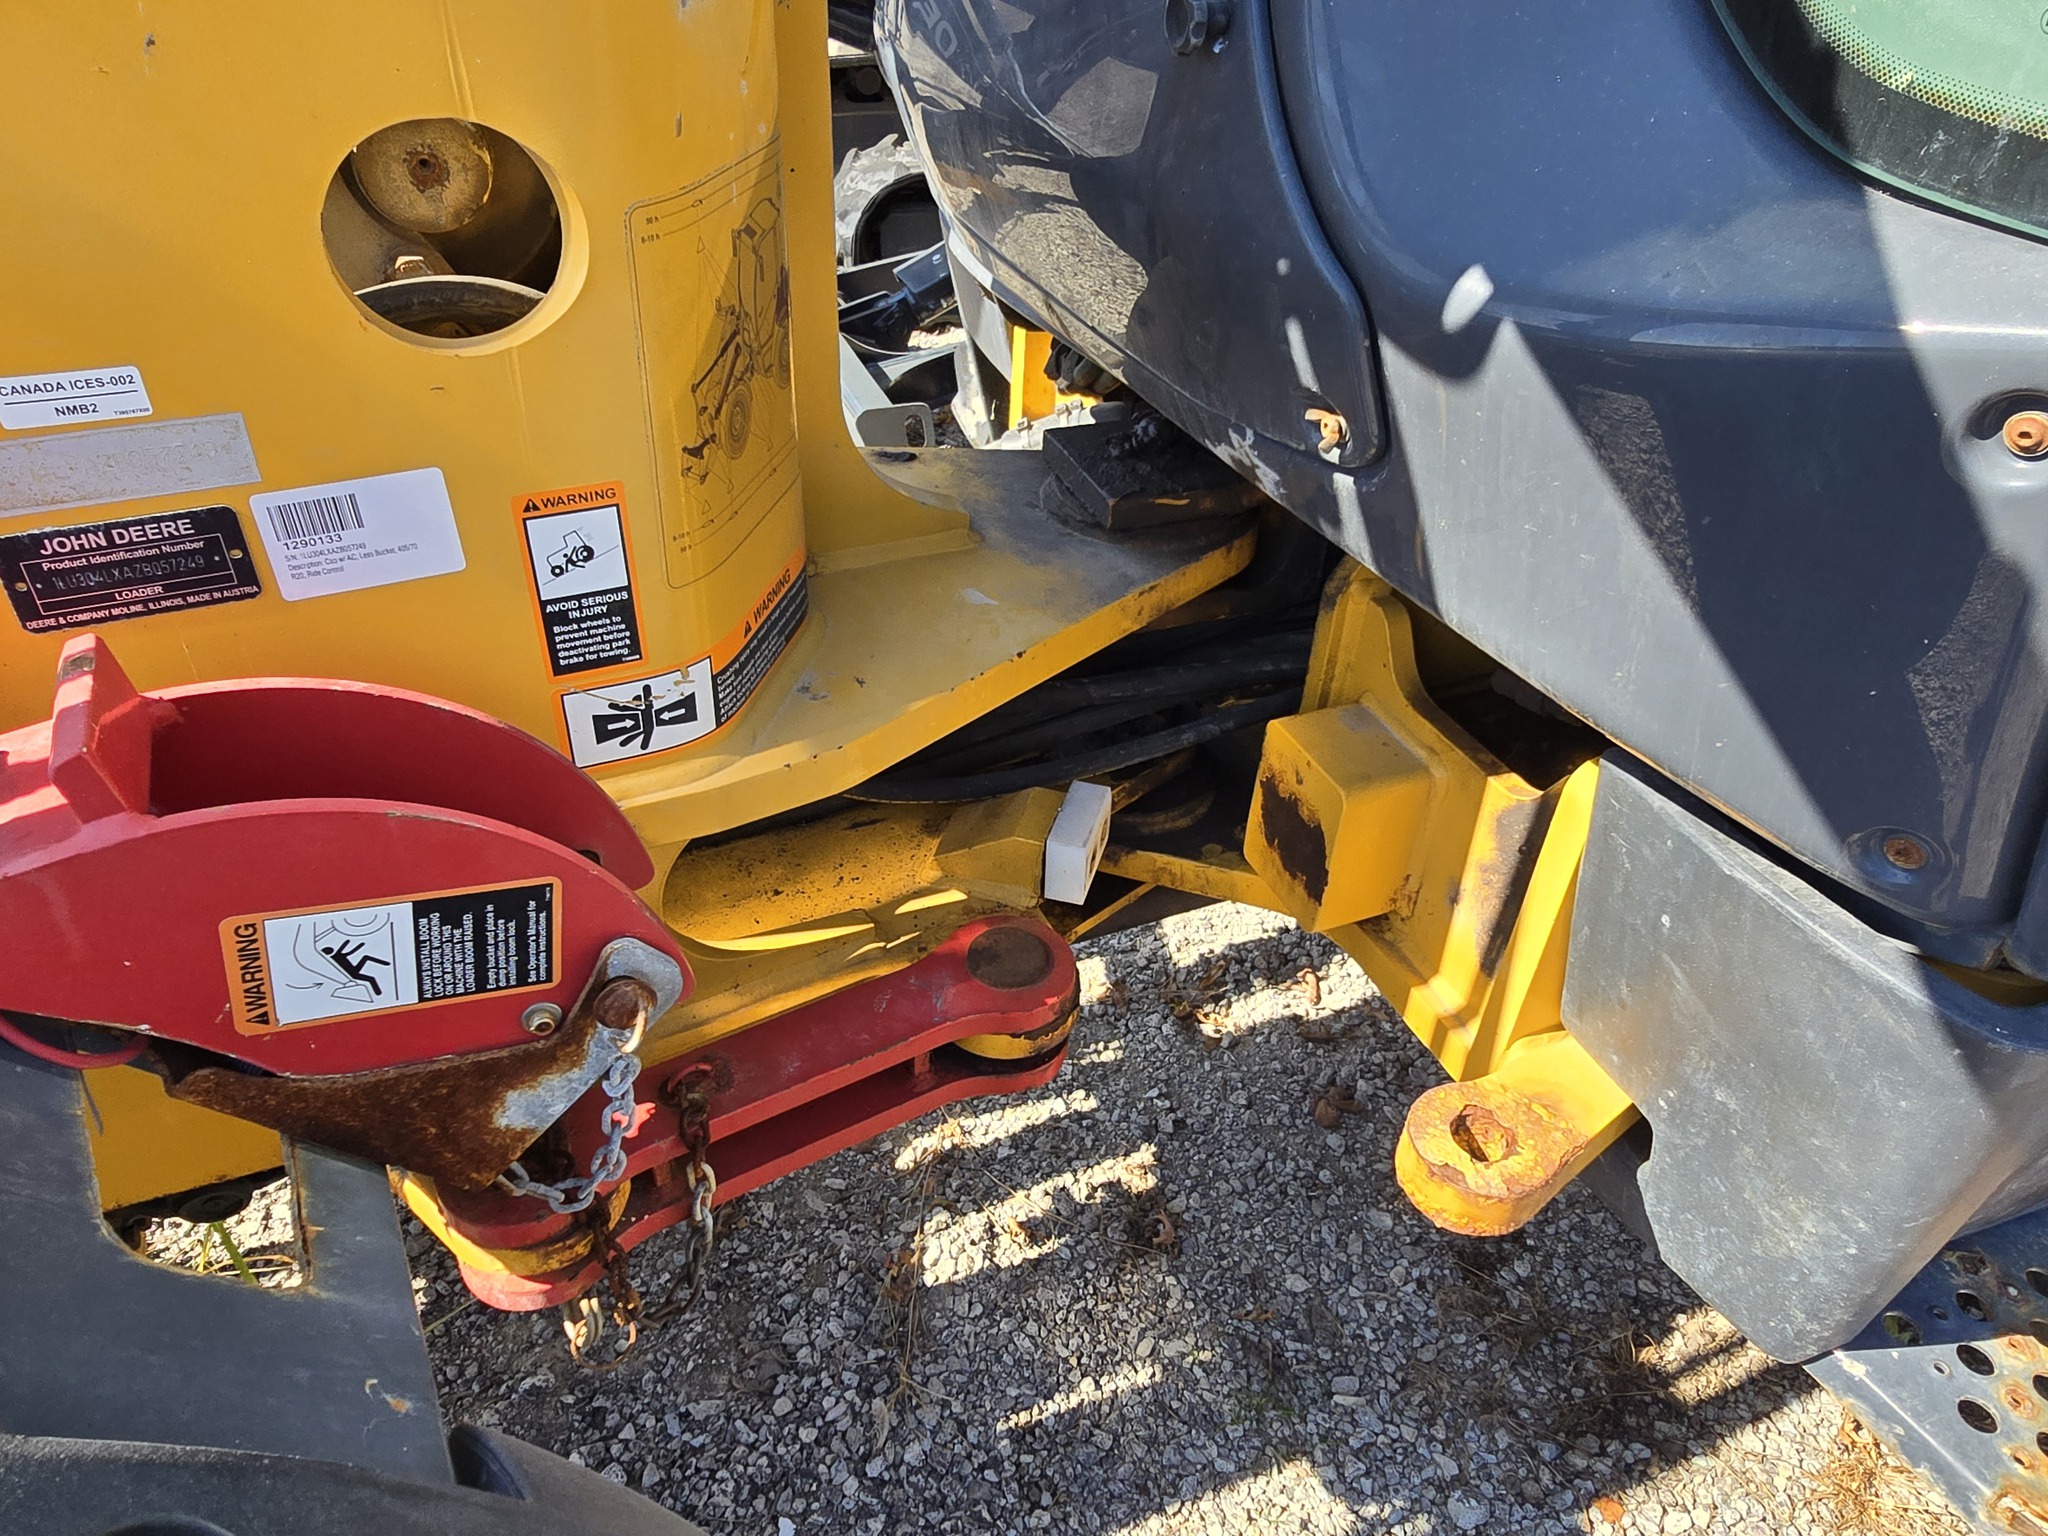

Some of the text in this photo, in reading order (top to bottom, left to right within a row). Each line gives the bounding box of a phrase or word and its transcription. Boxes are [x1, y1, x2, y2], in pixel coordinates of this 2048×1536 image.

[0, 374, 136, 397] CANADA ICES-002
[54, 403, 99, 417] NMB2
[540, 488, 617, 509] WARNING
[40, 519, 195, 555] JOHN DEERE
[283, 533, 343, 551] 1290133
[42, 541, 204, 571] Product Identification Number
[26, 618, 58, 630] DEERE
[58, 617, 67, 625] &
[67, 610, 110, 623] COMPANY
[186, 592, 212, 604] MADE
[212, 590, 222, 599] IN
[223, 585, 260, 597] AUSTRIA
[114, 586, 164, 601] LOADER
[546, 591, 629, 613] AVOID SERIOUS
[753, 567, 791, 625] WARNING
[553, 623, 579, 634] Block
[580, 617, 611, 629] wheels
[568, 605, 608, 619] INJURY
[555, 623, 626, 643] prevent machine
[556, 631, 631, 650] movement before
[558, 642, 610, 658] deactivating
[612, 638, 631, 649] park
[559, 655, 584, 666] brake
[585, 653, 598, 661] for
[599, 647, 631, 658] towing.
[418, 917, 433, 998] ALWAYS INSTALL BOOM
[429, 912, 444, 997] LOCK BEFORE WORKING
[463, 911, 476, 992] LOADER BOOM RAISED.
[484, 904, 497, 989] Empty bucket and place in
[496, 919, 507, 987] dump position before
[506, 919, 518, 986] installing boom lock.
[526, 900, 537, 982] See Operator's Manual for
[538, 910, 548, 981] complete instructions.
[233, 922, 268, 1013] WARNING
[442, 925, 454, 996] ON OR AROUND THIS
[453, 928, 465, 994] MACHINE WITH THE
